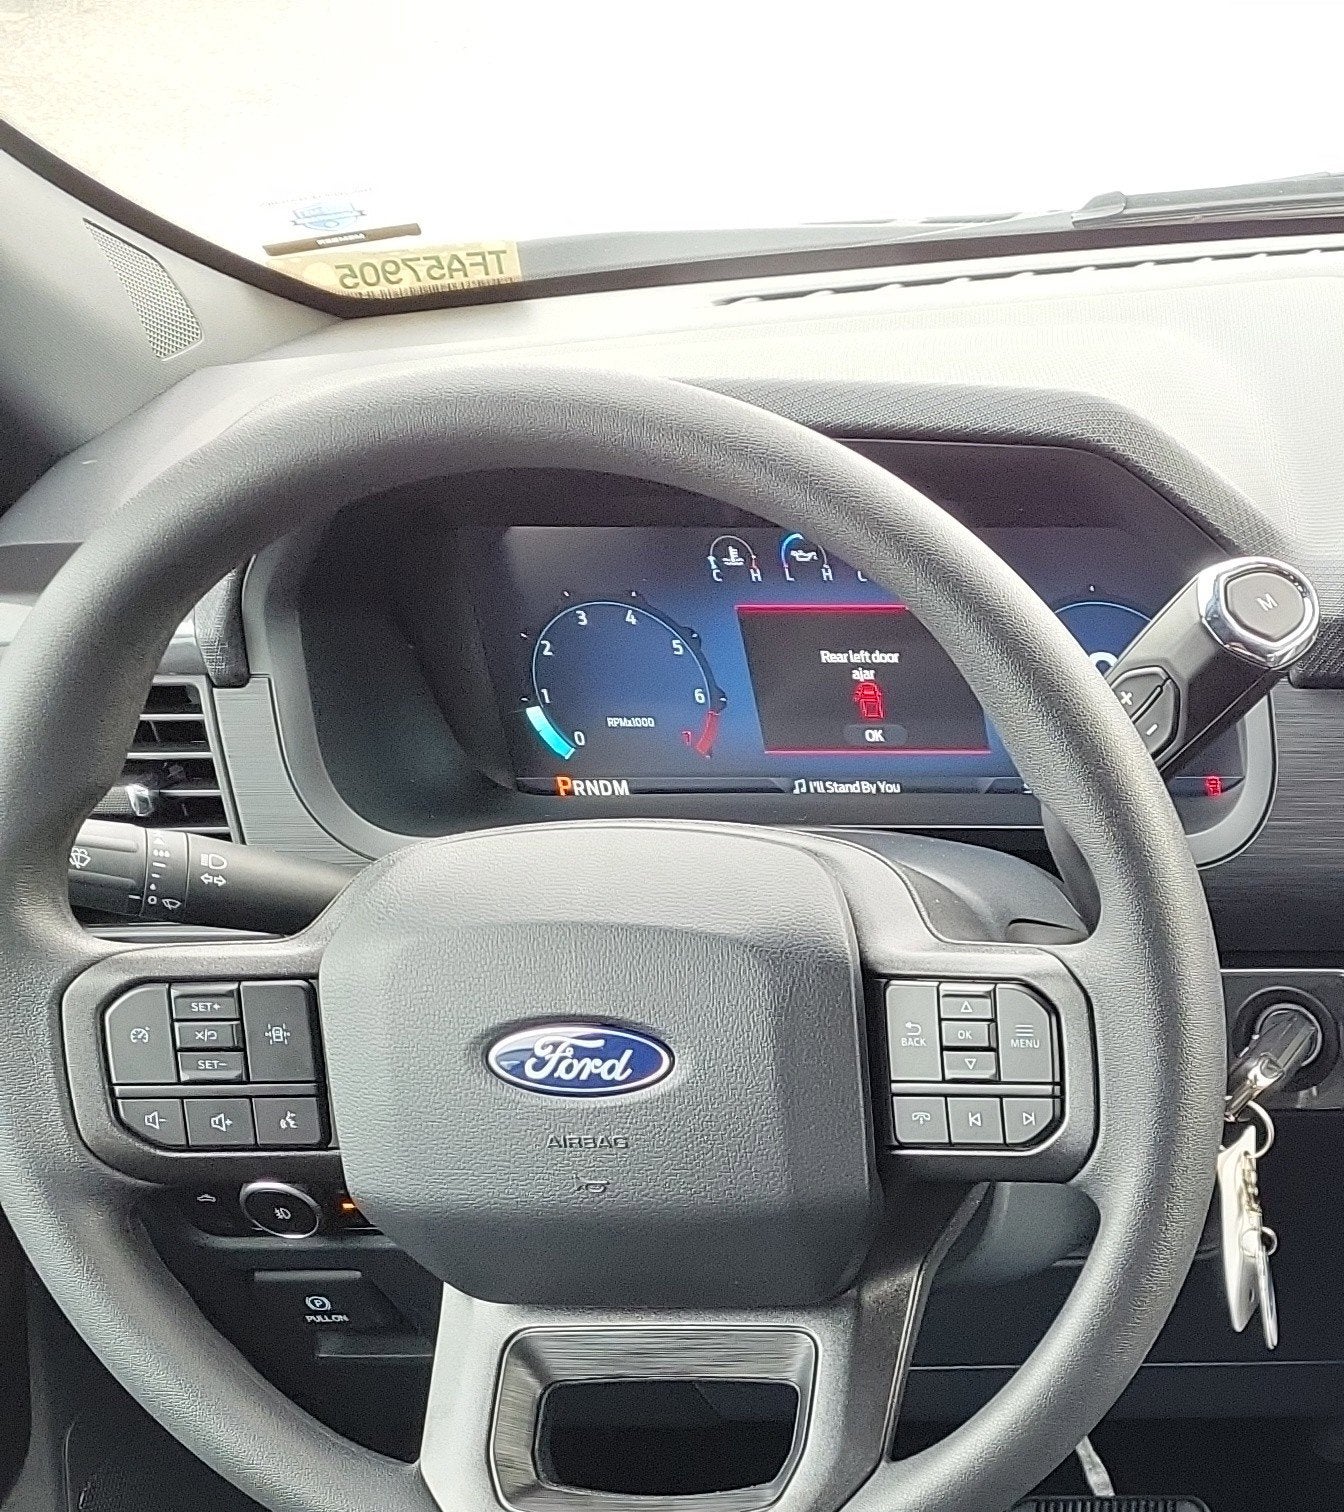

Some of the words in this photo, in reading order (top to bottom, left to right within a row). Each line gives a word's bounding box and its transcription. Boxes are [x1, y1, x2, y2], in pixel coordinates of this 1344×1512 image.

[1256, 594, 1279, 612] M
[575, 610, 588, 626] 3
[625, 609, 637, 625] 4
[540, 640, 554, 656] 2
[671, 640, 684, 656] 5
[820, 650, 848, 664] Rear
[849, 650, 872, 664] left
[873, 650, 900, 663] door
[851, 667, 876, 682] ajar
[541, 688, 551, 704] 1
[694, 688, 706, 704] 6
[574, 731, 586, 746] 0
[682, 731, 692, 746] 7
[864, 730, 886, 743] OK
[826, 781, 860, 794] Stand
[861, 781, 877, 795] By
[877, 781, 901, 794] You
[957, 1028, 973, 1040] OK
[901, 1036, 928, 1048] BACK
[1011, 1038, 1041, 1050] MENU
[524, 1035, 635, 1083] Ford
[545, 1133, 631, 1150] AIRBAG
